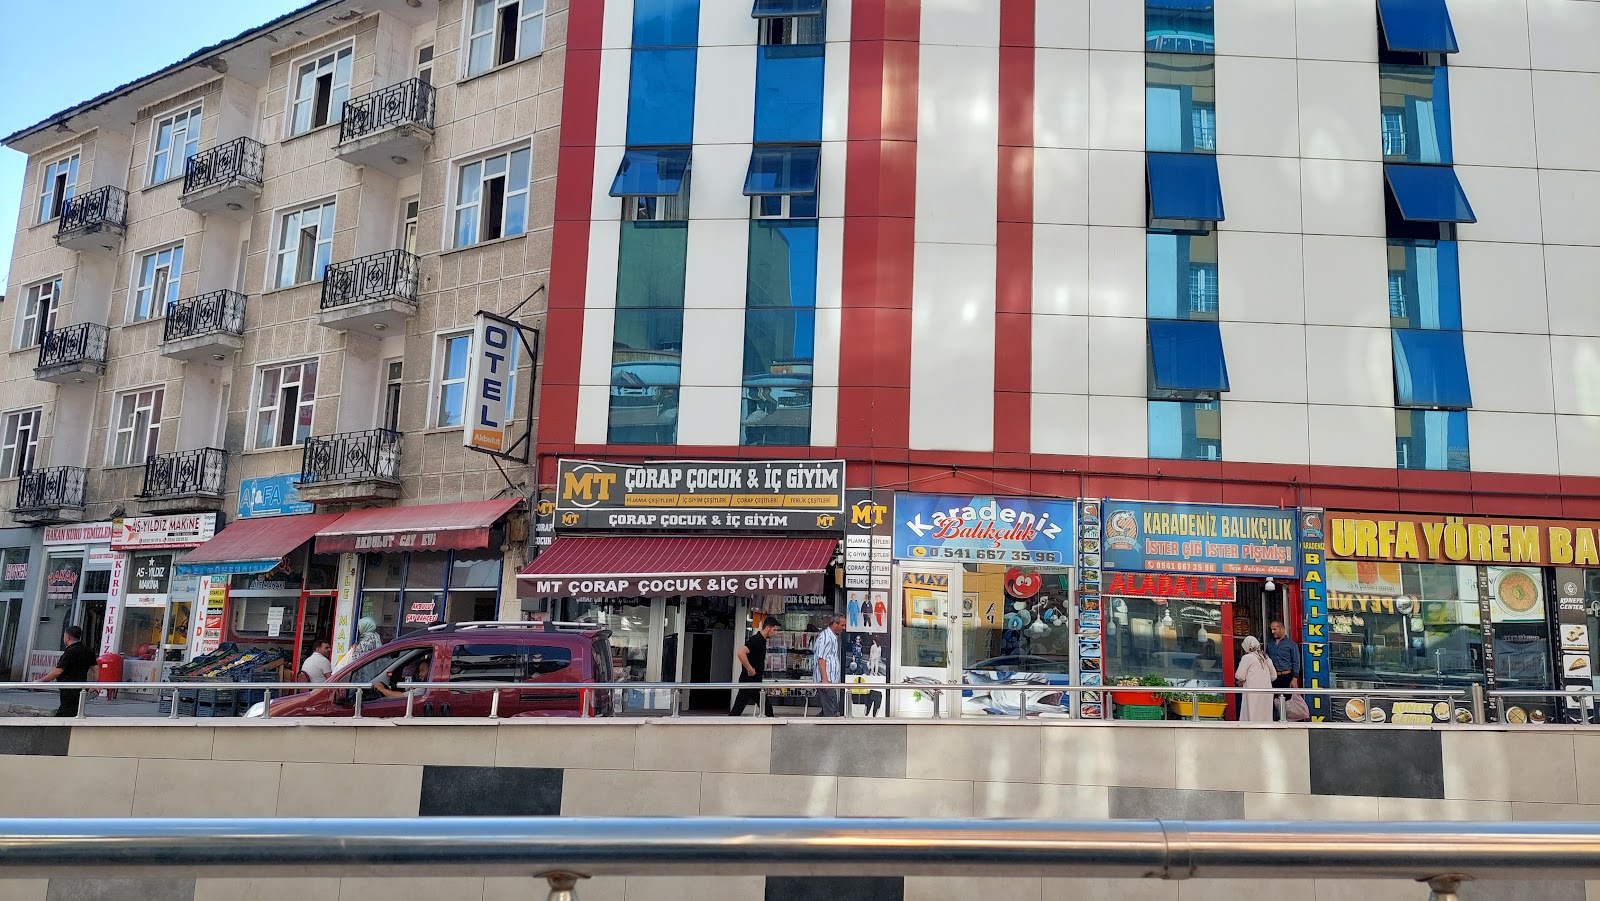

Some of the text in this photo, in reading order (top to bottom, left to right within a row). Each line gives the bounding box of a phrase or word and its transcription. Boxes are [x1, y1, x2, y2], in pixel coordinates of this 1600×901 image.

[480, 325, 508, 428] OTEL
[474, 433, 501, 445] Akbulut
[563, 463, 838, 500] MT ÇORAP ÇOCUK & İÇ GİYİM
[537, 502, 555, 514] MT
[851, 505, 887, 524] MT
[168, 516, 200, 531] MAKİNE
[561, 513, 579, 524] MT
[608, 512, 788, 528] ÇORAP ÇOCUK & İÇ GİYİM
[816, 516, 835, 527] MT
[906, 500, 1063, 540] Karadeniz
[932, 517, 1039, 549] Balıkçılık
[1143, 511, 1293, 545] KARADENİZ BALIKÇILIK
[355, 535, 395, 549] AKBULUT
[866, 538, 890, 546] ÇŞİTLERİ
[1331, 516, 1600, 565] URFA YÖREM BA
[976, 549, 1006, 560] 667
[1011, 550, 1031, 561] 35
[1035, 551, 1056, 562] 96
[1145, 538, 1179, 555] İSTER
[1205, 541, 1239, 559] İSTER
[1241, 542, 1292, 564] PİŞMİŞ!
[1156, 561, 1176, 570] 0541
[1177, 562, 1191, 571] 667
[1192, 563, 1203, 572] 35
[47, 570, 78, 586] HAKAN
[112, 561, 124, 597] KURU
[536, 581, 562, 593] MT
[568, 580, 629, 596] ÇORAP
[638, 578, 702, 595] ÇOCUK
[744, 574, 799, 590] GİYİM
[865, 579, 889, 587] ÇŞİTLERİ
[1109, 573, 1233, 598] ALABALIK
[1304, 552, 1324, 722] BALIKÇILIK
